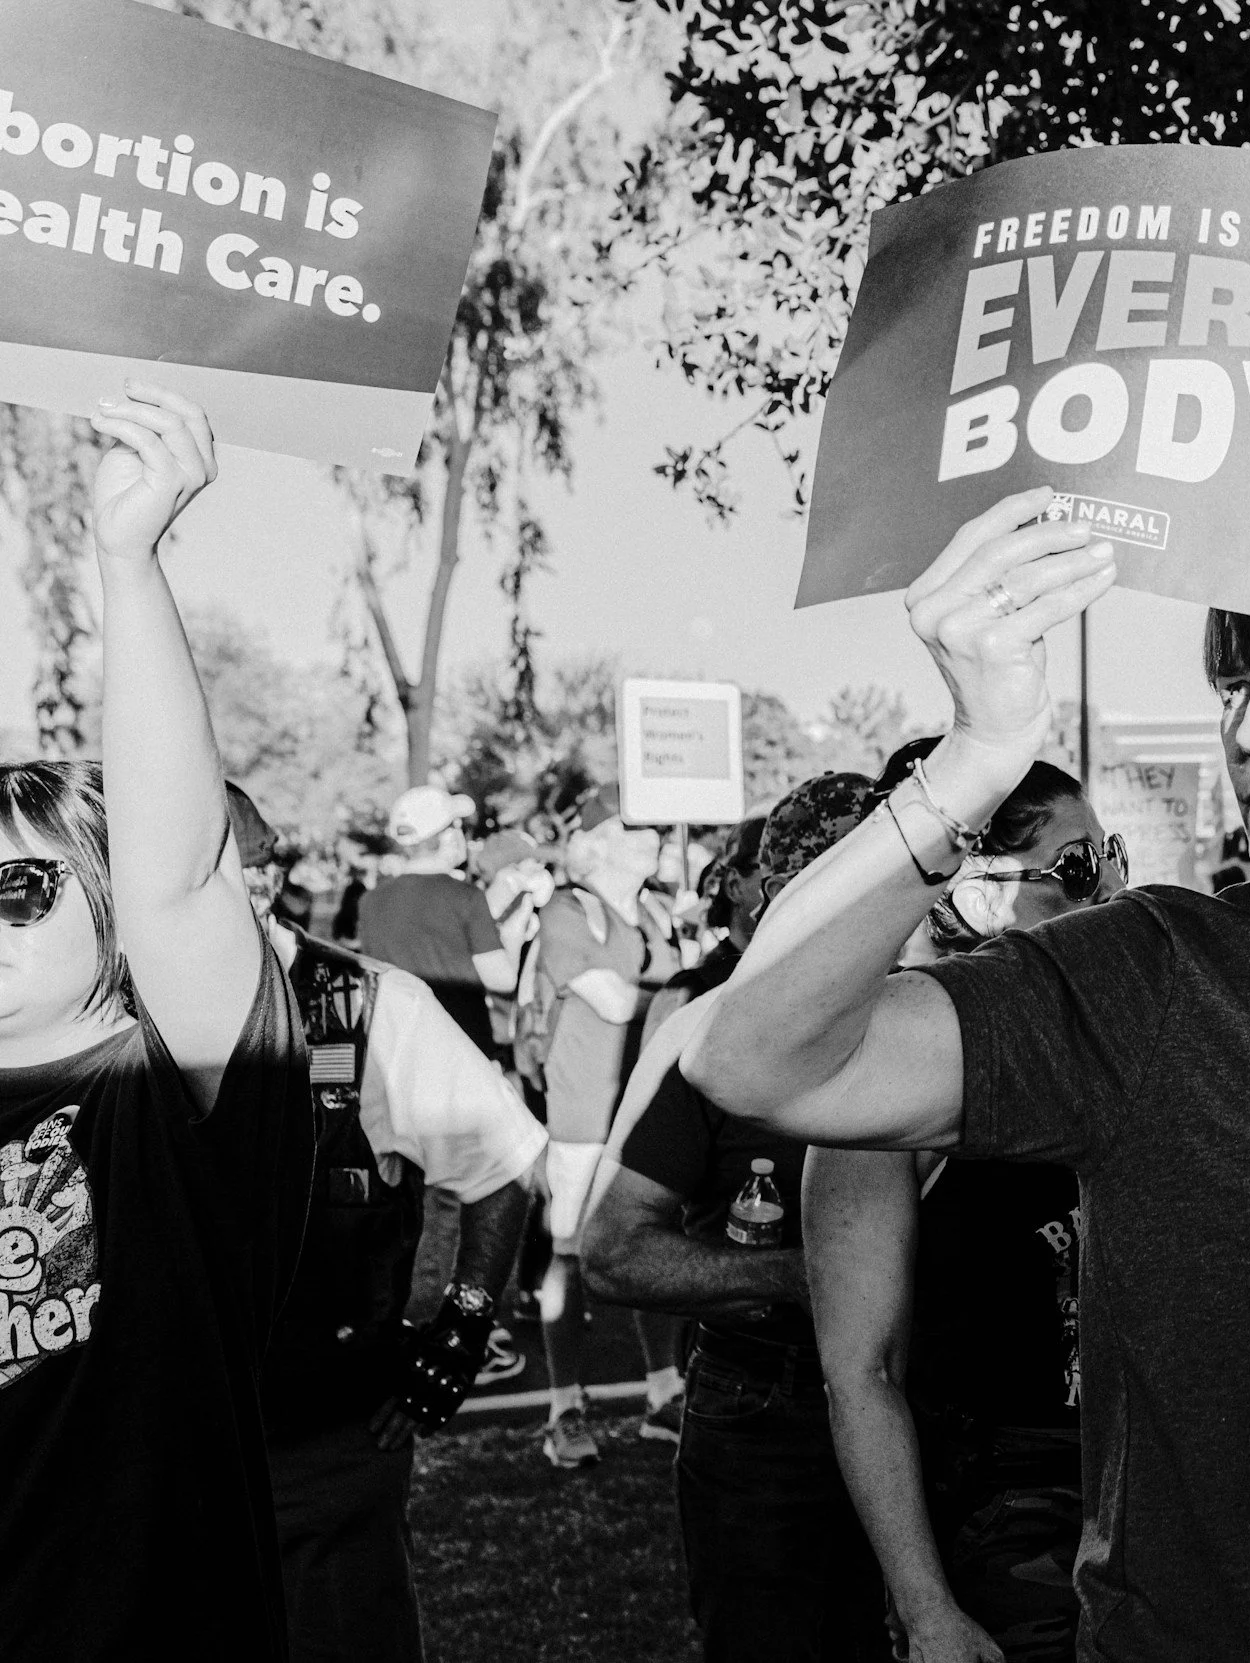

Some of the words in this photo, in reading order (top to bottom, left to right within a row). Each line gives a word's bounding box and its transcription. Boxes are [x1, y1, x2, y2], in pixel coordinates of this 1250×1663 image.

[0, 89, 287, 221] bortion
[304, 172, 364, 240] is
[0, 189, 184, 275] ealth
[206, 233, 382, 323] Care.
[973, 205, 1172, 258] FREEDOM
[1198, 208, 1241, 248] IS
[1078, 502, 1160, 534] NARAL
[1162, 798, 1188, 817] TO
[0, 1284, 101, 1360] her
